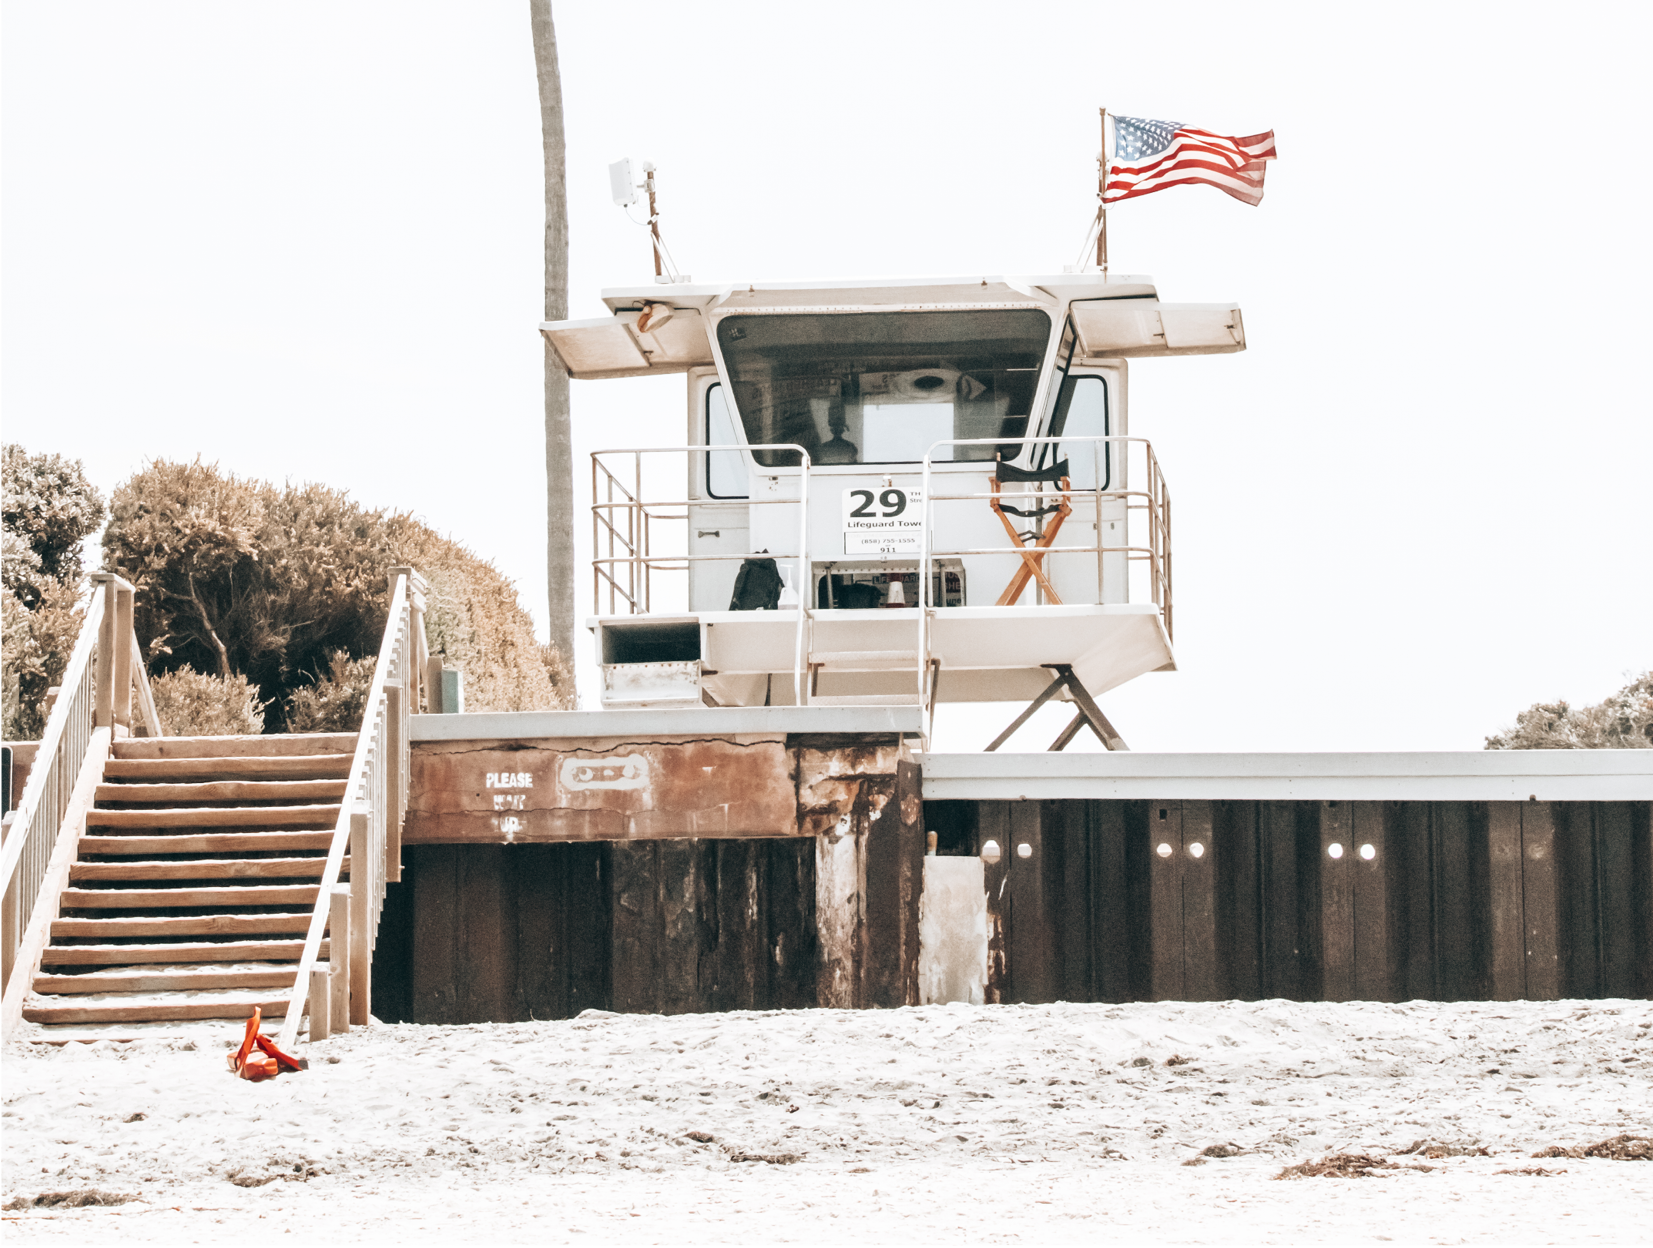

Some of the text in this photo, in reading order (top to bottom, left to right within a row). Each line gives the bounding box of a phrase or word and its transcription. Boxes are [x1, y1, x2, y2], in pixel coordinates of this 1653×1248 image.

[849, 489, 907, 518] 29
[847, 521, 895, 529] Lifeguard
[486, 772, 533, 788] PLEASE
